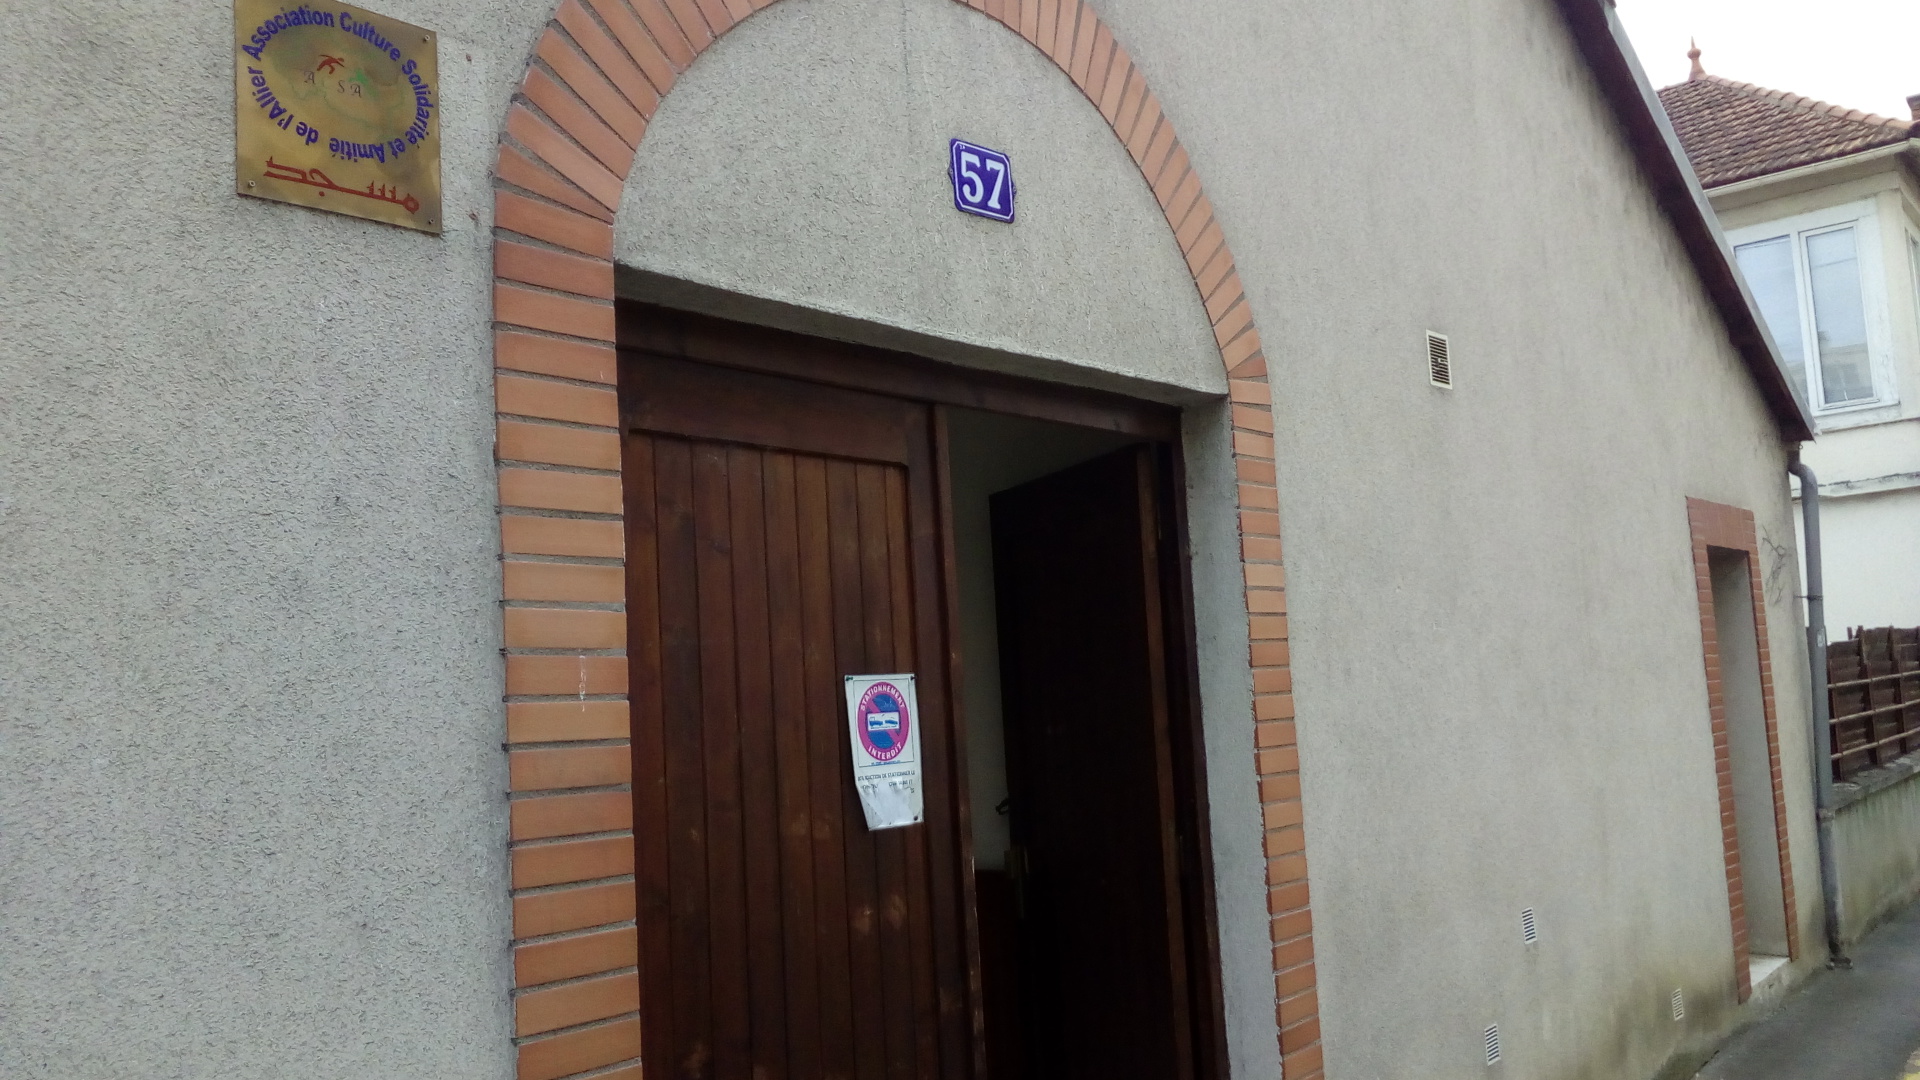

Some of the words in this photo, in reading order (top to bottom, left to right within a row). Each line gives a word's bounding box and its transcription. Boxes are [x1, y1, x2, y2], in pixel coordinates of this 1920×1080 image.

[242, 5, 335, 61] Association
[339, 12, 401, 62] Culture
[295, 121, 319, 146] de
[387, 138, 406, 159] et
[960, 150, 1005, 210] 57
[860, 684, 905, 712] STATIONNEMENT
[868, 741, 903, 761] INTERDIT
